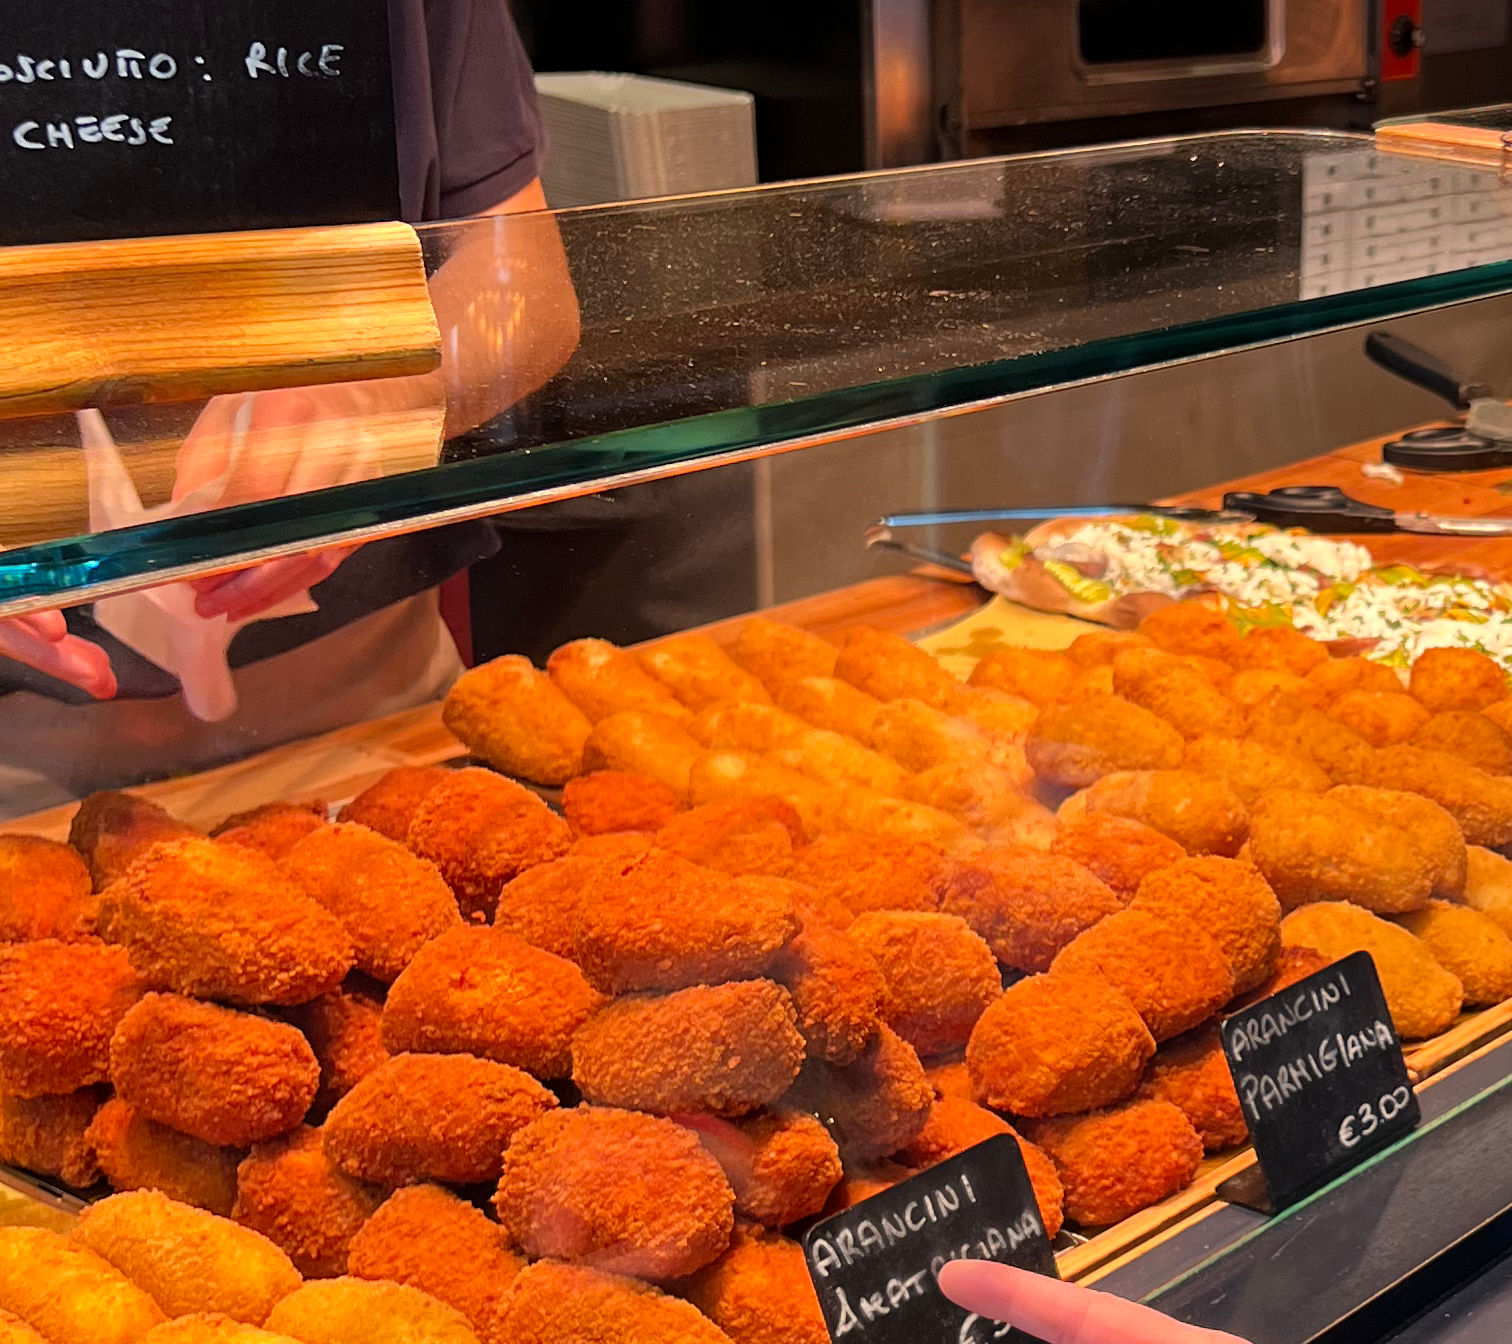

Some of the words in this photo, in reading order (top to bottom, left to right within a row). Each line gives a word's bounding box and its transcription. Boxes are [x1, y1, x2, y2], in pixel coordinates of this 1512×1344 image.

[244, 41, 345, 78] RICE
[12, 113, 175, 150] CHEESE
[1230, 972, 1351, 1062] ARANCINI
[1239, 1019, 1395, 1121] PARMIGIANA
[1337, 1085, 1410, 1148] €3.00
[811, 1173, 977, 1278] ARANCINI
